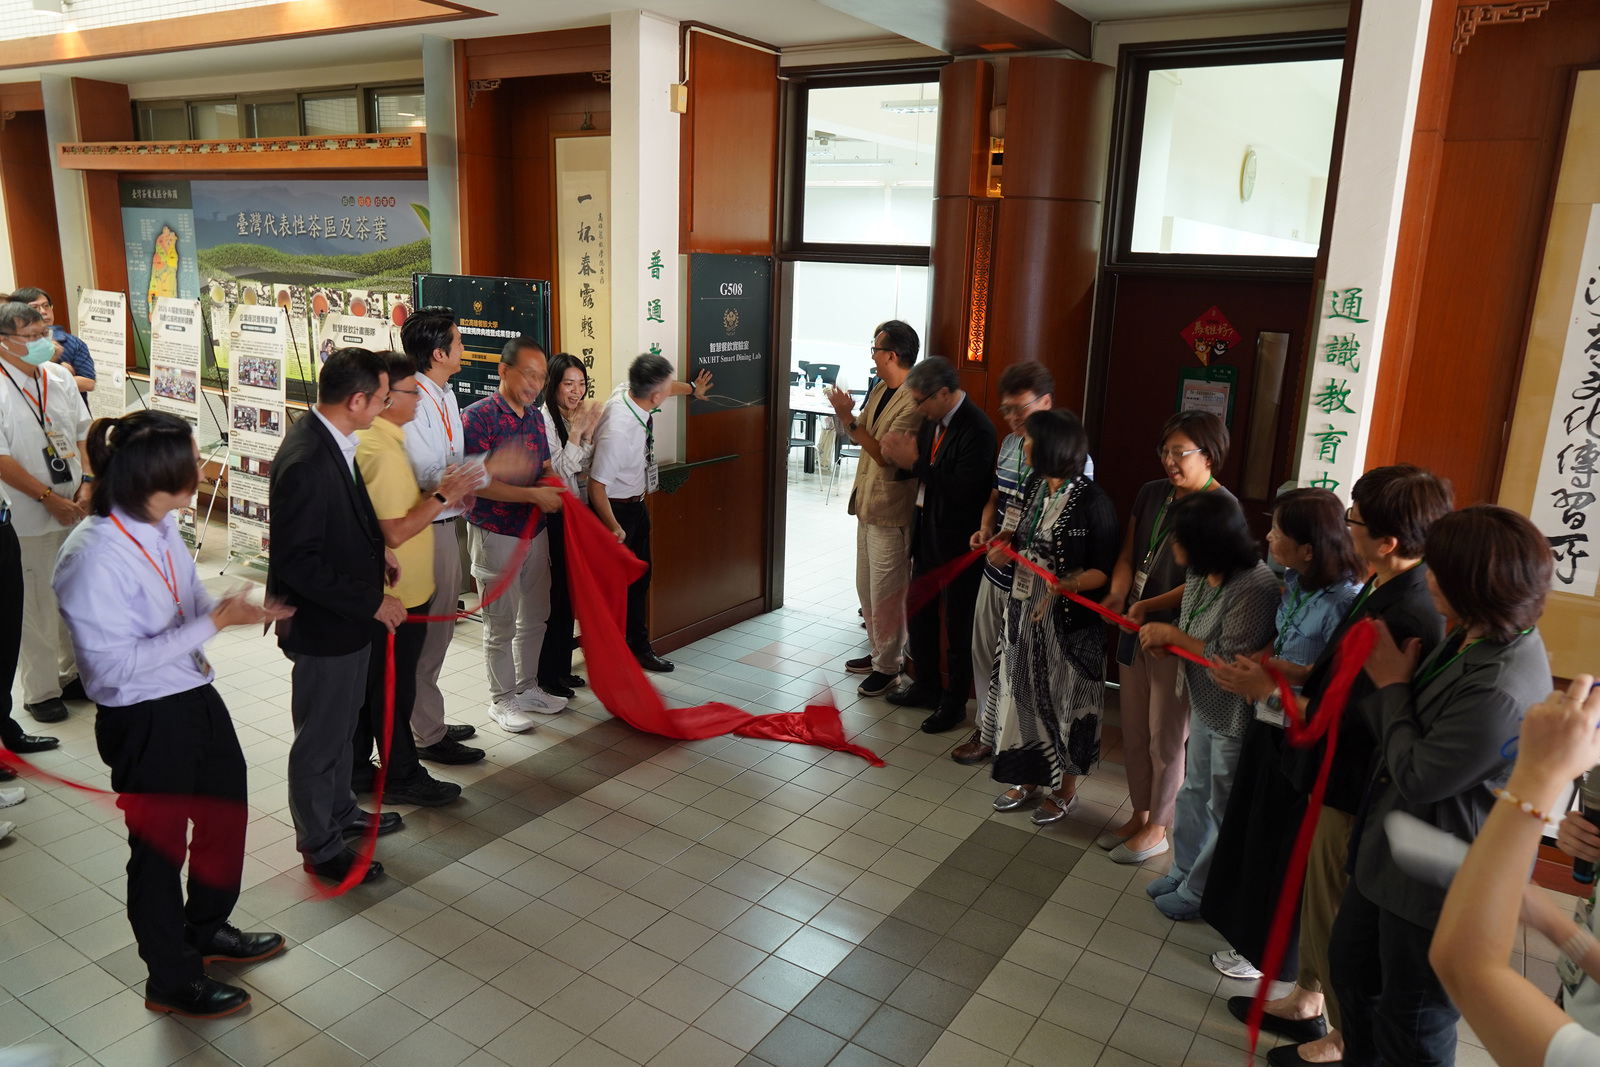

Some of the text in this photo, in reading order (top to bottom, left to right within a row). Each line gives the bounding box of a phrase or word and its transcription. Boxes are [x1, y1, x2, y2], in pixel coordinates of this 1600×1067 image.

[236, 212, 388, 242] 臺灣代表性茶區及茶葉
[720, 283, 743, 296] G508
[698, 352, 761, 364] NKUHT Smart Dining Lab
